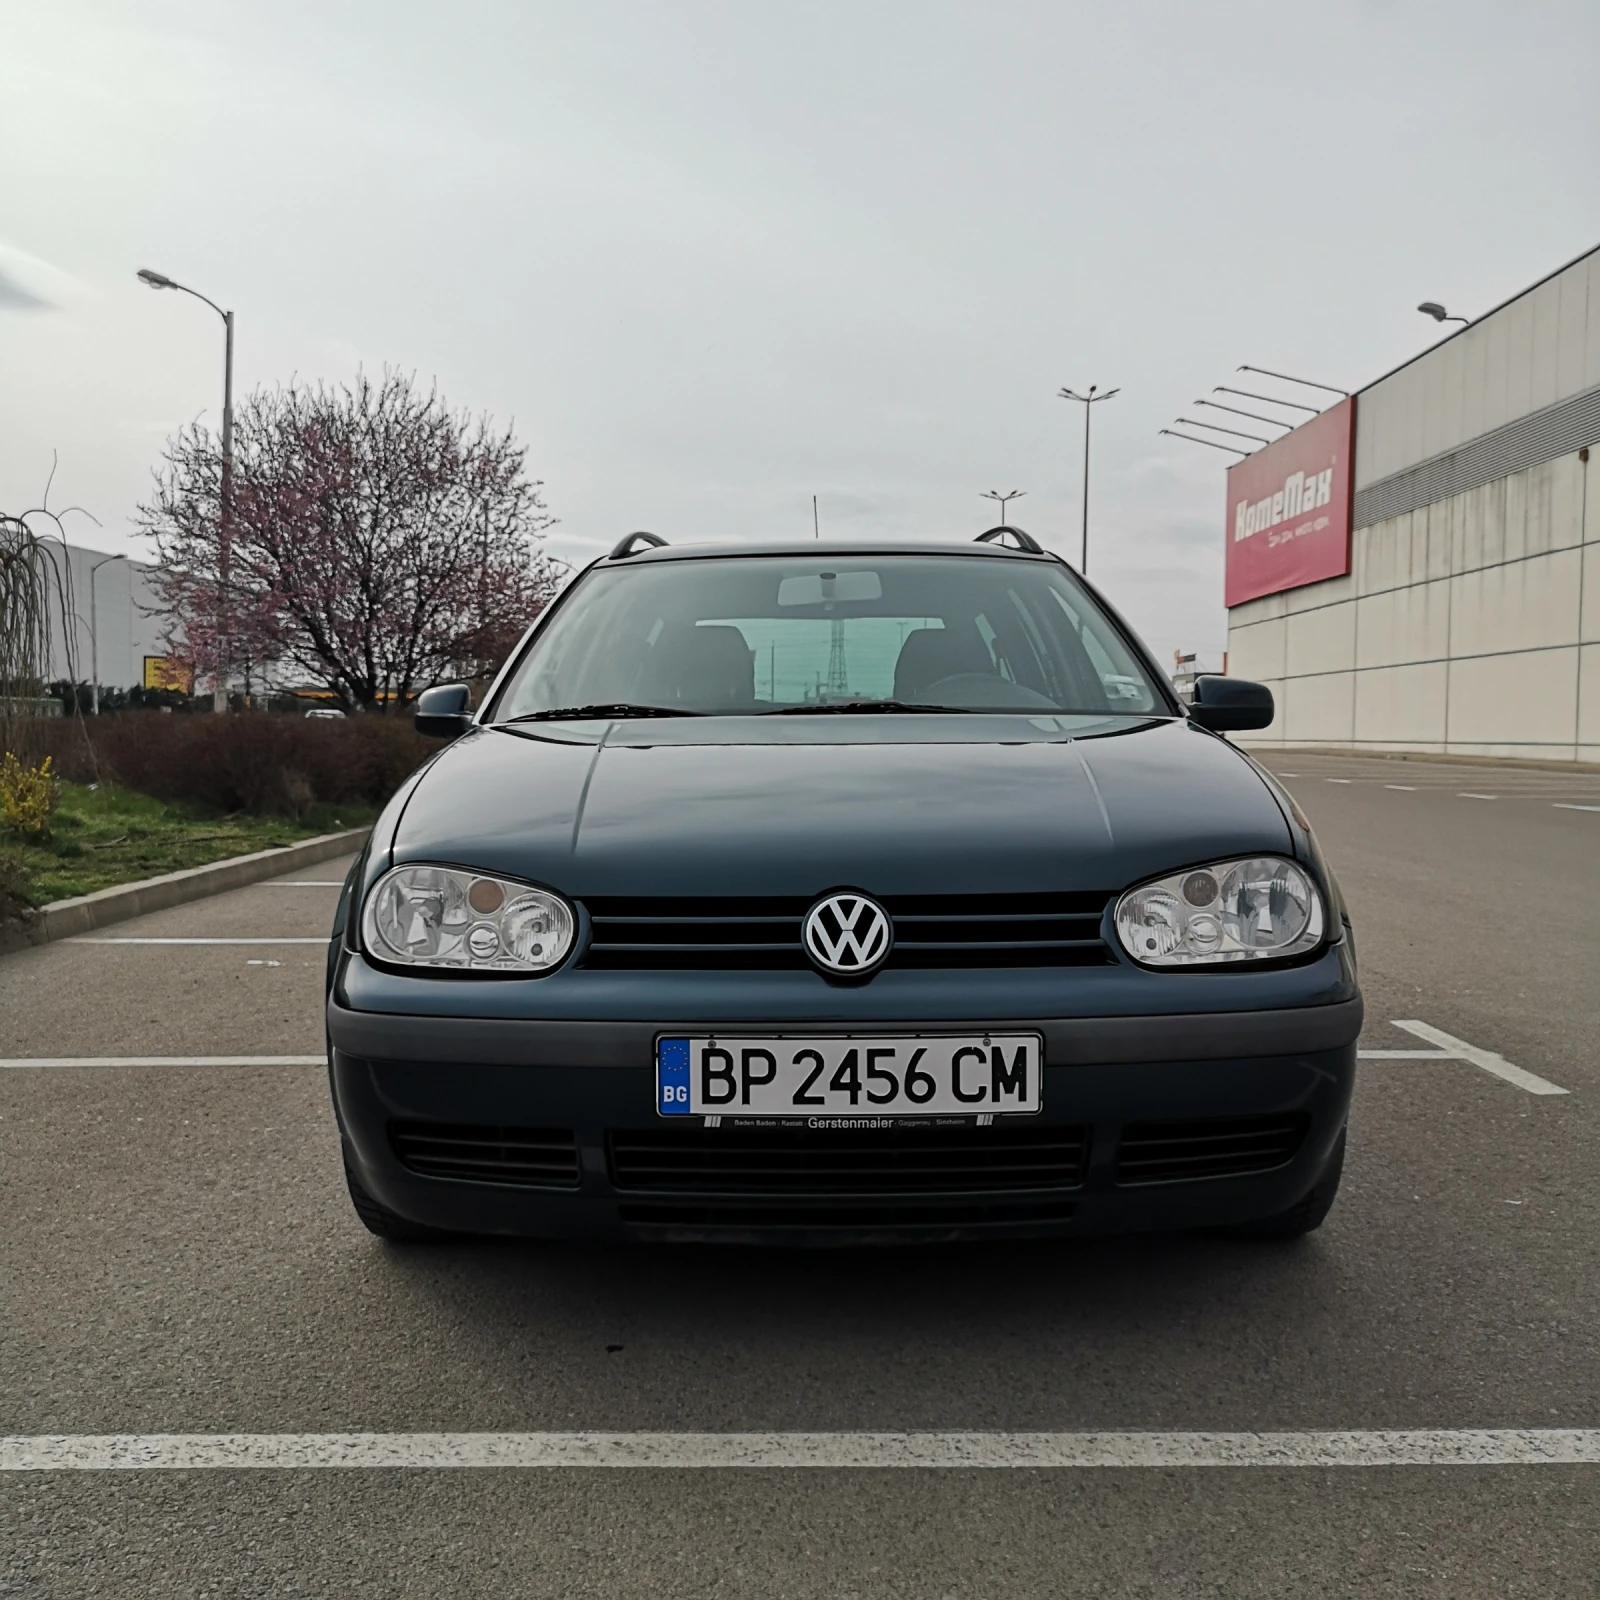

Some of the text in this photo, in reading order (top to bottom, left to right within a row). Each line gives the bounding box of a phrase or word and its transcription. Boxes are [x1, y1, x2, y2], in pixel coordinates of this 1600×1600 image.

[1235, 468, 1333, 542] HomeMax
[806, 895, 889, 970] VW
[663, 1085, 688, 1103] BG
[701, 1046, 1028, 1106] BP 2456 CM
[807, 1116, 894, 1129] Gerstenmaier
